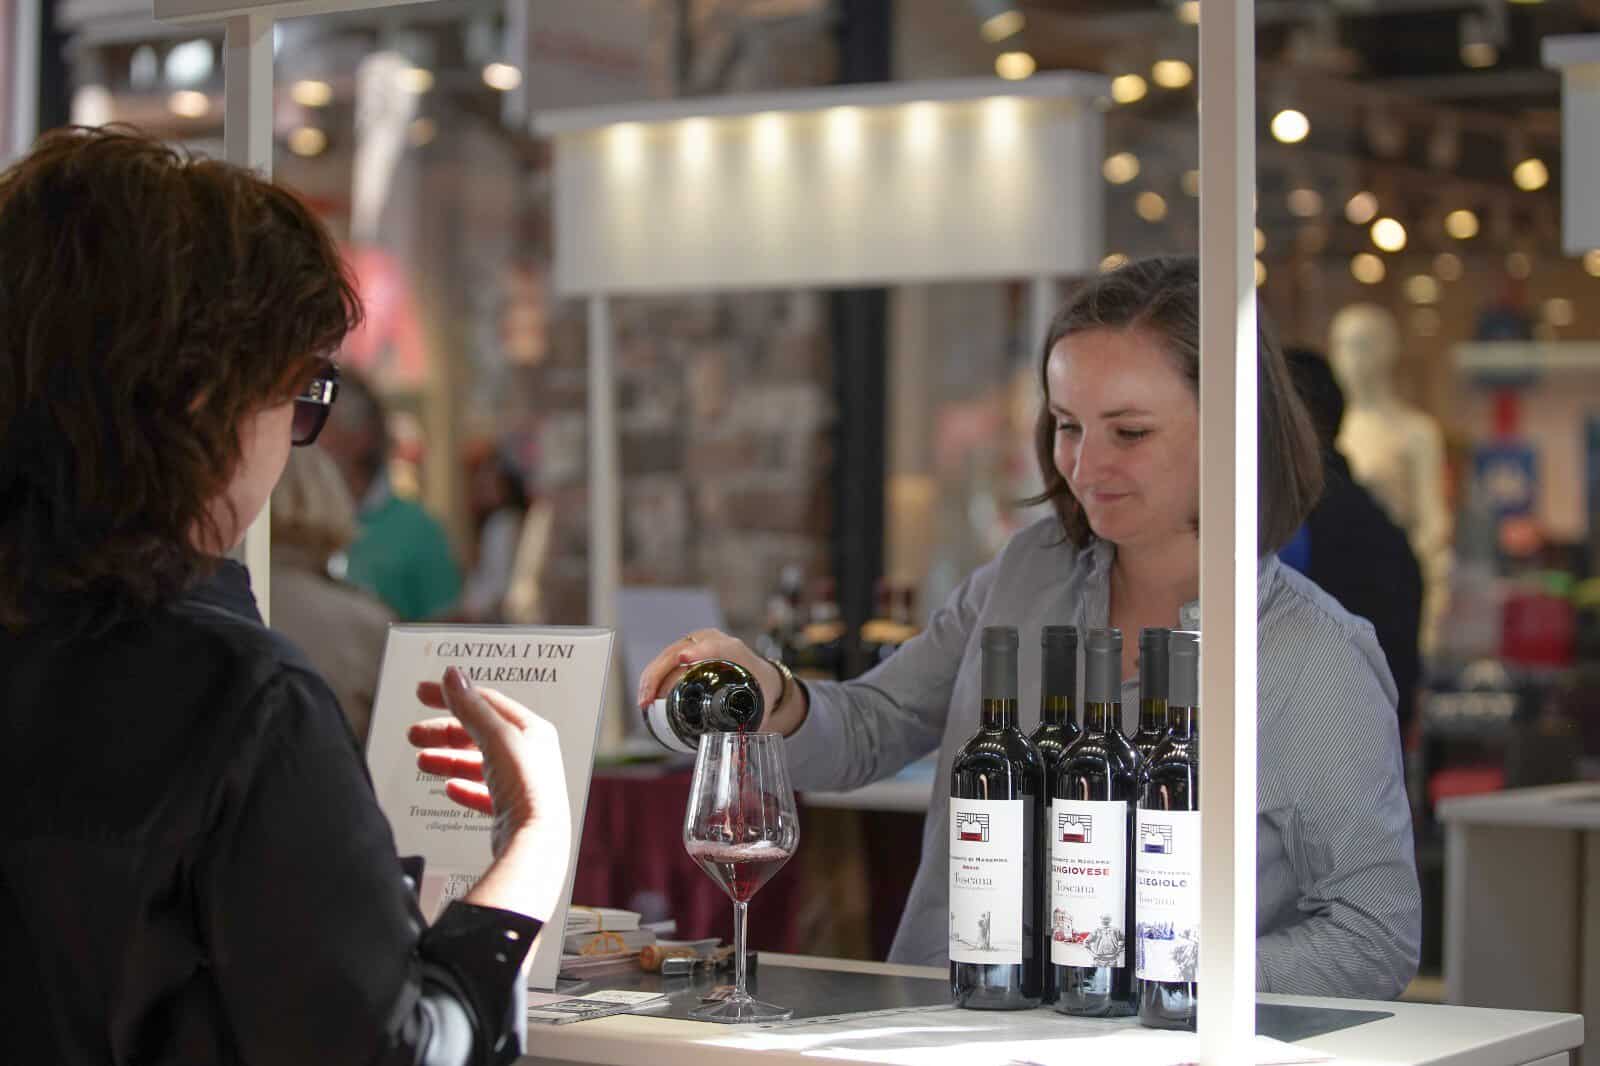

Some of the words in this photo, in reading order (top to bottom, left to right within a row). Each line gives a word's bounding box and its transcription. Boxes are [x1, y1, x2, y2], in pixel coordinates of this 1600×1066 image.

[436, 641, 517, 658] CANTINA
[522, 642, 532, 659] I
[536, 643, 575, 659] VINI
[468, 666, 558, 683] MAREMMA
[1051, 863, 1112, 877] ANGIOVESE
[952, 871, 993, 887] Toscana
[1055, 879, 1096, 895] Toscana
